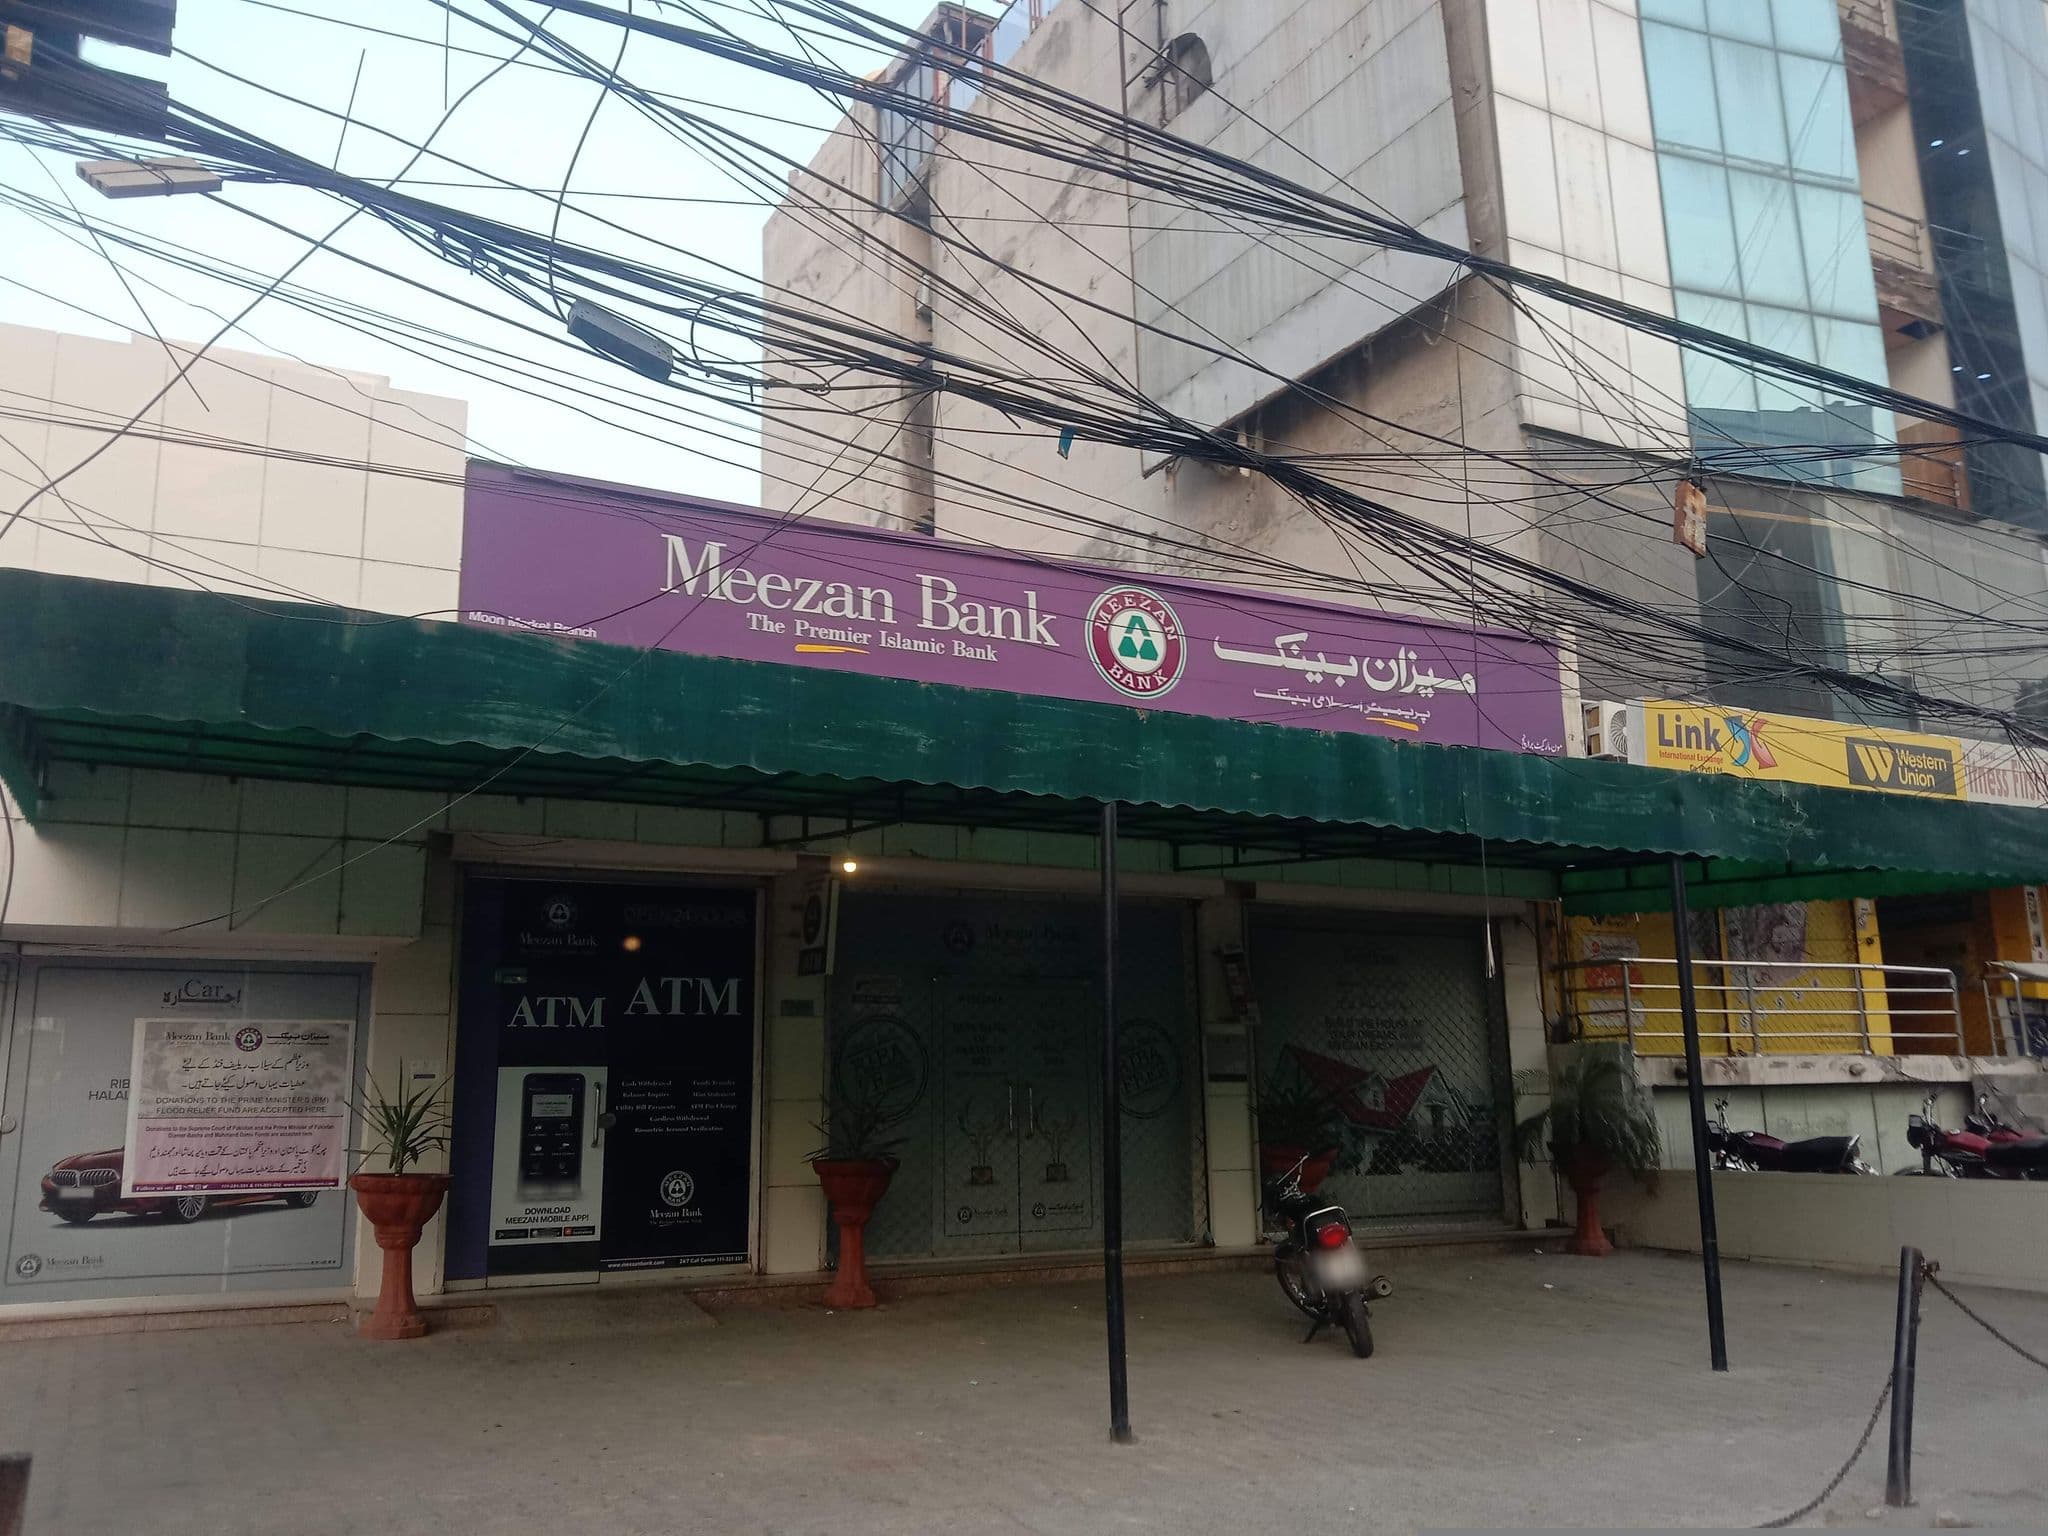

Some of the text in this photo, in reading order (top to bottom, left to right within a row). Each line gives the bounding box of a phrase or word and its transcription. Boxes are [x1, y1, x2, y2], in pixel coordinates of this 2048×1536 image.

[659, 533, 1061, 648] Meezan Bank
[468, 611, 505, 626] Moon
[553, 622, 597, 638] Branch
[1095, 593, 1178, 641] MEEZAN
[746, 612, 998, 663] The Premier Islamic Bank
[1108, 662, 1168, 689] BANK
[1213, 632, 1478, 699] میزان بینک
[1657, 713, 1723, 752] Link
[1657, 750, 1698, 761] International
[1896, 748, 1948, 773] Western
[1898, 766, 1936, 788] Union
[1969, 759, 2010, 798] itness
[519, 931, 600, 947] Meezan Bank
[184, 979, 224, 998] Car
[624, 976, 743, 1017] ATM
[507, 995, 607, 1029] ATM
[167, 1031, 230, 1041] Meezan Bank
[110, 1078, 131, 1089] RIB
[88, 1090, 129, 1101] HALAL
[156, 1096, 206, 1105] DONATIONS
[207, 1096, 218, 1104] TO
[220, 1096, 237, 1104] THE
[156, 1105, 327, 1115] FLOOD RELIEF FUND ARE ACCEPTED HERE
[505, 1216, 539, 1225] MEEZAN
[540, 1215, 570, 1224] MOBILE
[525, 1206, 571, 1216] DOWNLOAD
[649, 1208, 703, 1219] Meezan Bank
